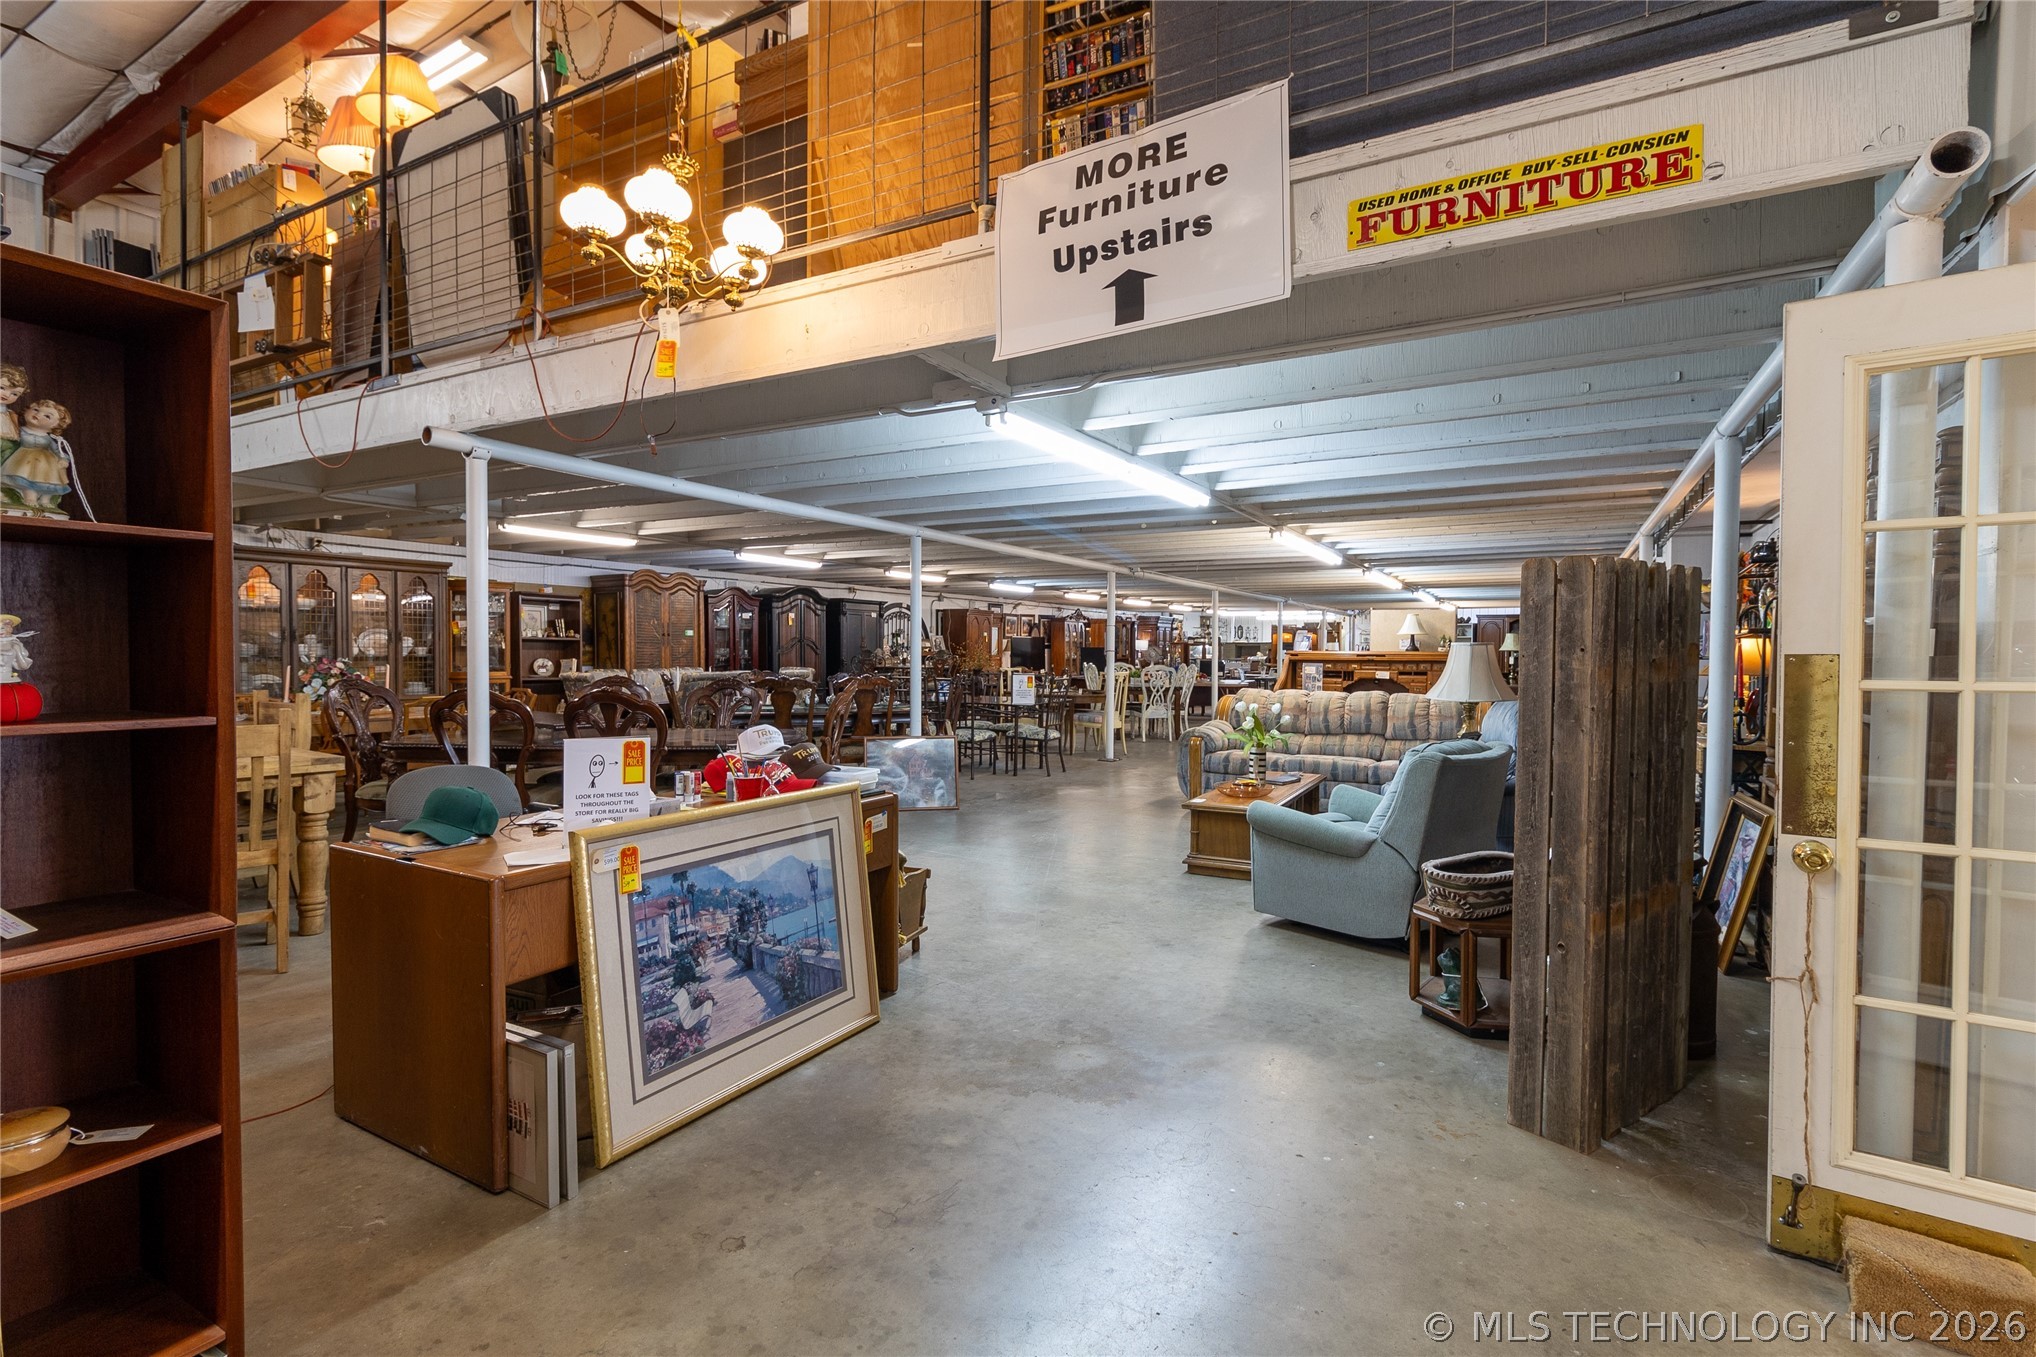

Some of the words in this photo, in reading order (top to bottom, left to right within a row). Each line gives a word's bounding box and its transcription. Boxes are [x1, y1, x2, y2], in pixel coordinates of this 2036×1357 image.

[1075, 132, 1187, 190] MORE
[1038, 163, 1228, 234] Furniture
[1356, 146, 1692, 247] FURNITURE
[1358, 195, 1396, 212] USED
[1398, 185, 1442, 203] HOME
[1444, 183, 1455, 193] &
[1458, 169, 1512, 190] OFFICE
[1053, 215, 1213, 274] Upstairs
[626, 758, 642, 766] PRICE
[628, 750, 641, 758] SALE
[793, 746, 818, 760] TRUM
[623, 856, 636, 865] SALE
[623, 864, 637, 874] PRICE
